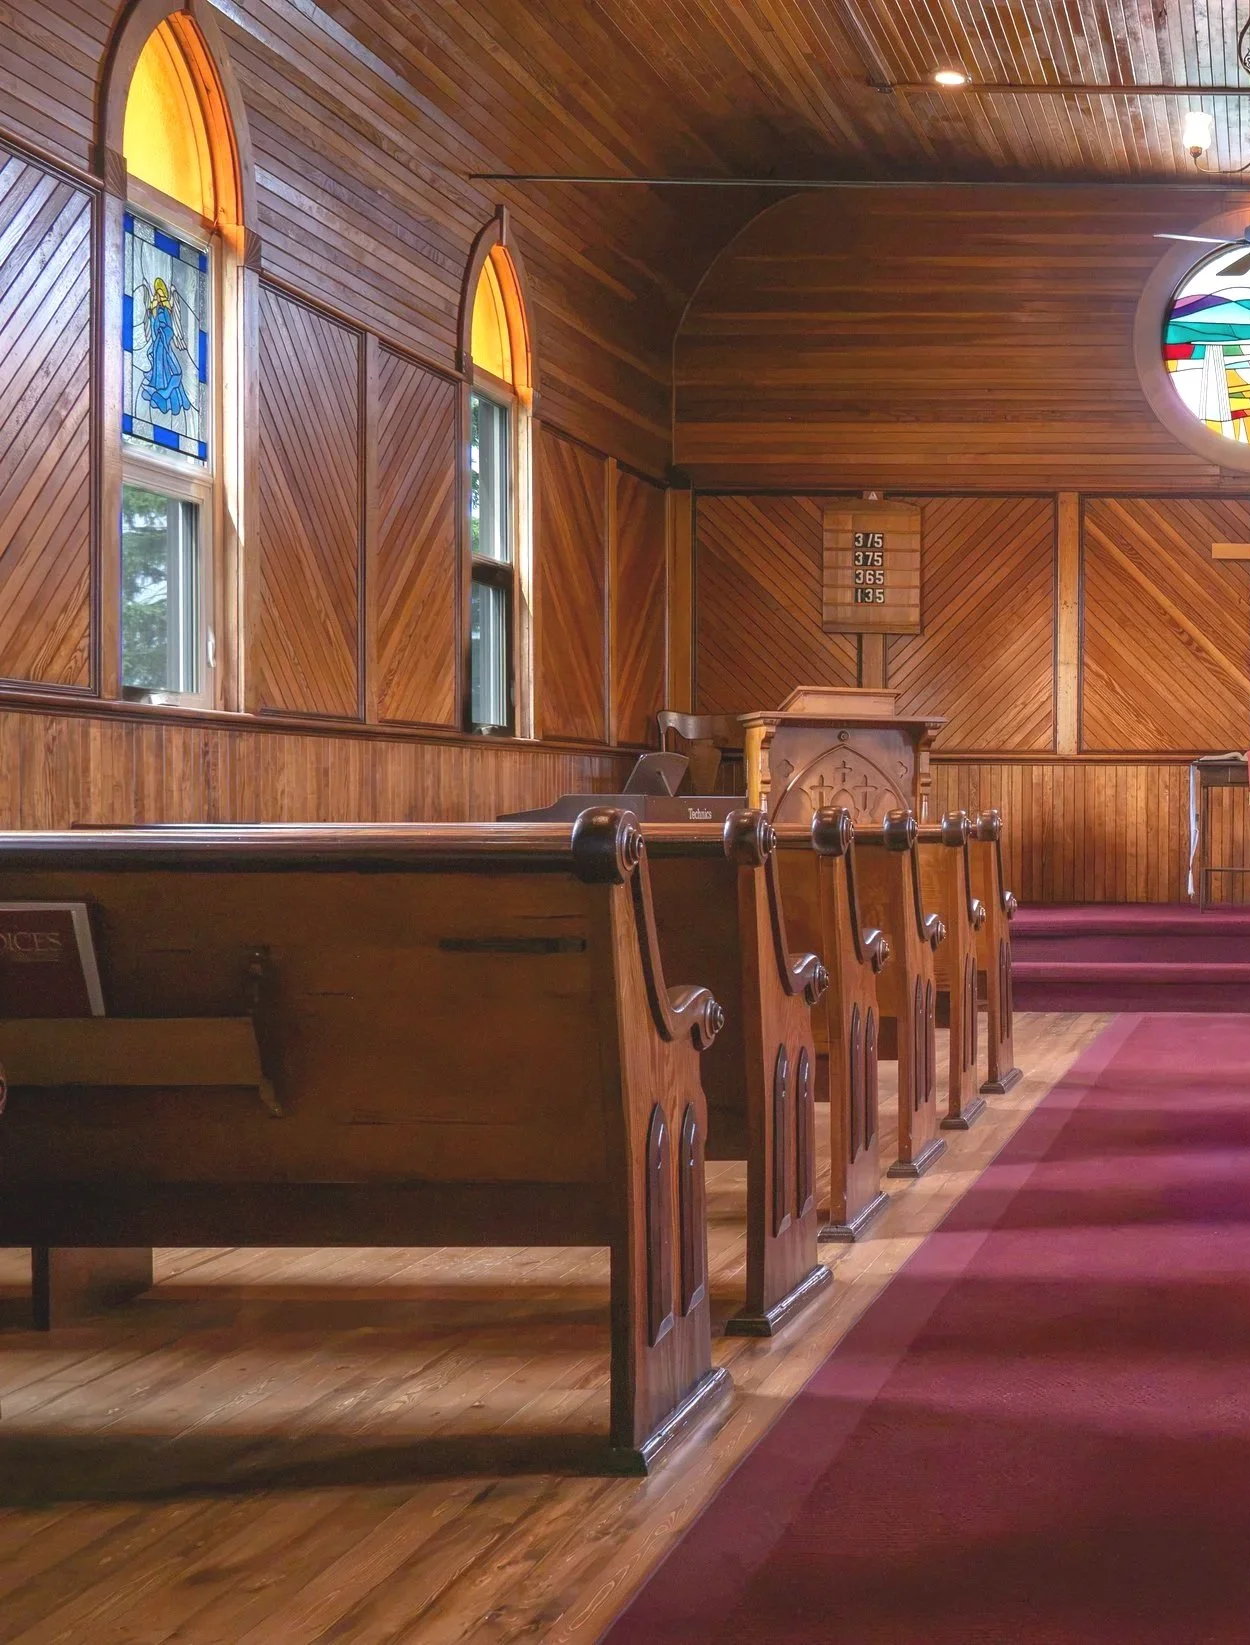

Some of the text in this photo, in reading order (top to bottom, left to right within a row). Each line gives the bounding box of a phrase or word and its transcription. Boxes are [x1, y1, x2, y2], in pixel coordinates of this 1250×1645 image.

[854, 551, 883, 566] 375
[855, 569, 884, 584] 365
[856, 588, 885, 603] 135
[688, 808, 712, 820] Technics
